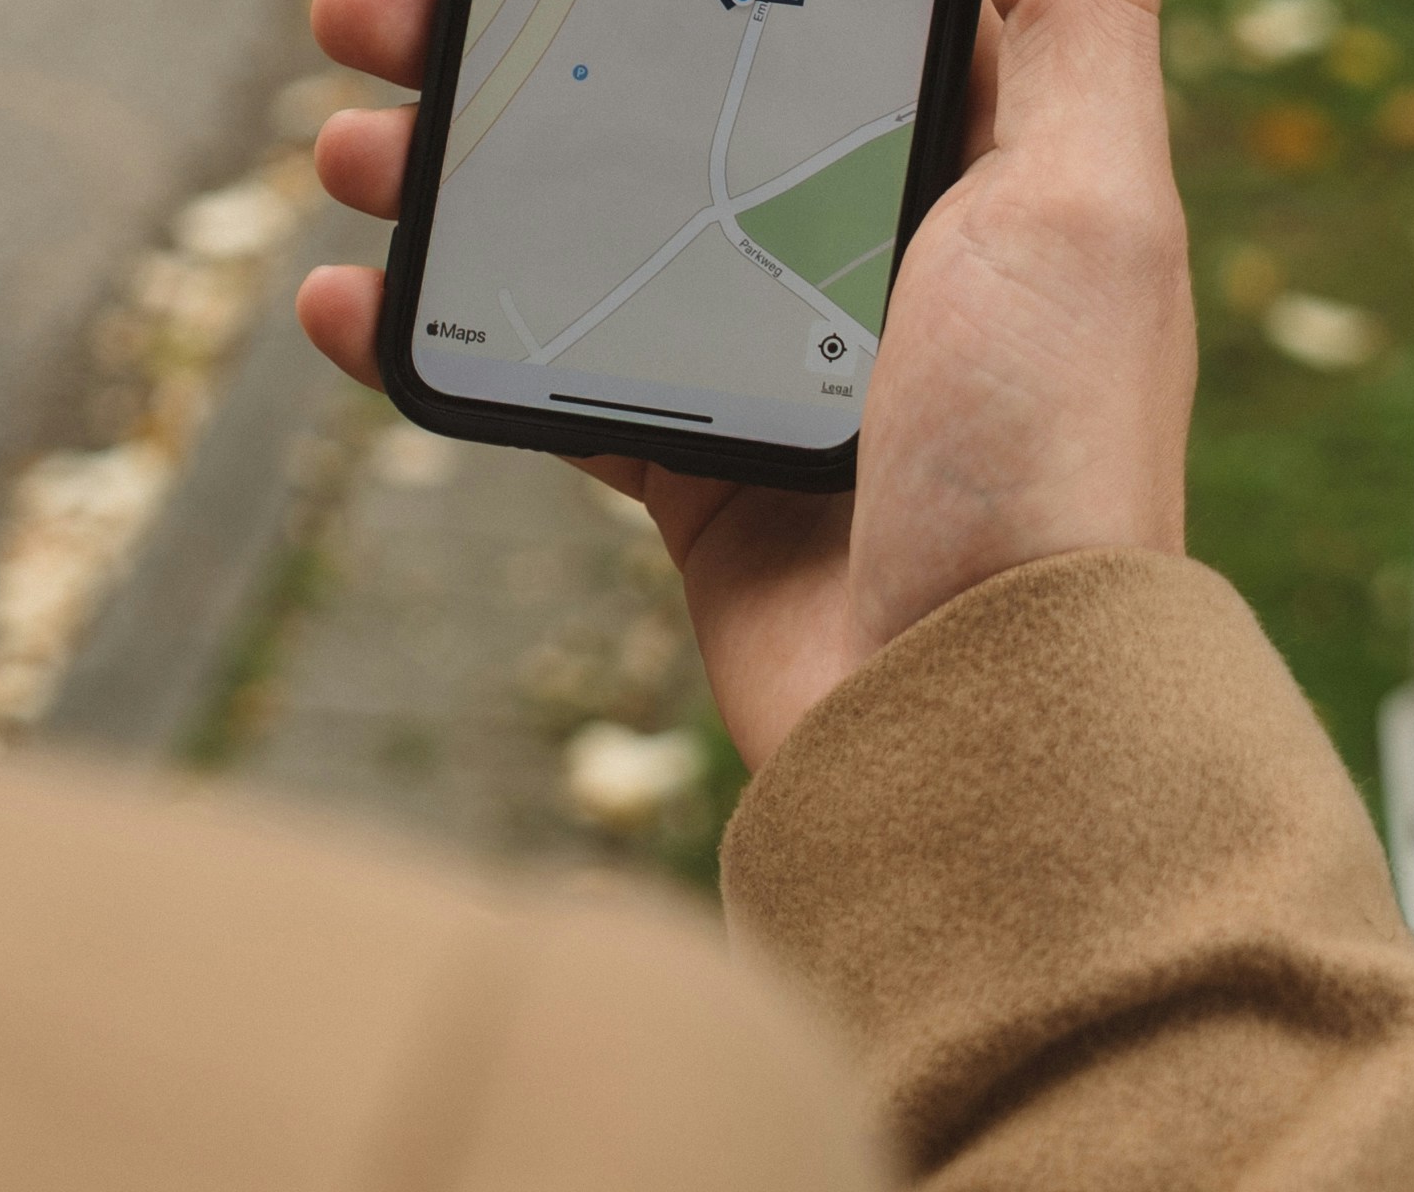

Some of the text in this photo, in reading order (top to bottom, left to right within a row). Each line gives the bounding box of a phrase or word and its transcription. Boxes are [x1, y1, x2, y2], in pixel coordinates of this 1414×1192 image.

[738, 238, 784, 279] Parkweg
[440, 321, 487, 345] Maps
[821, 381, 853, 397] Legal
